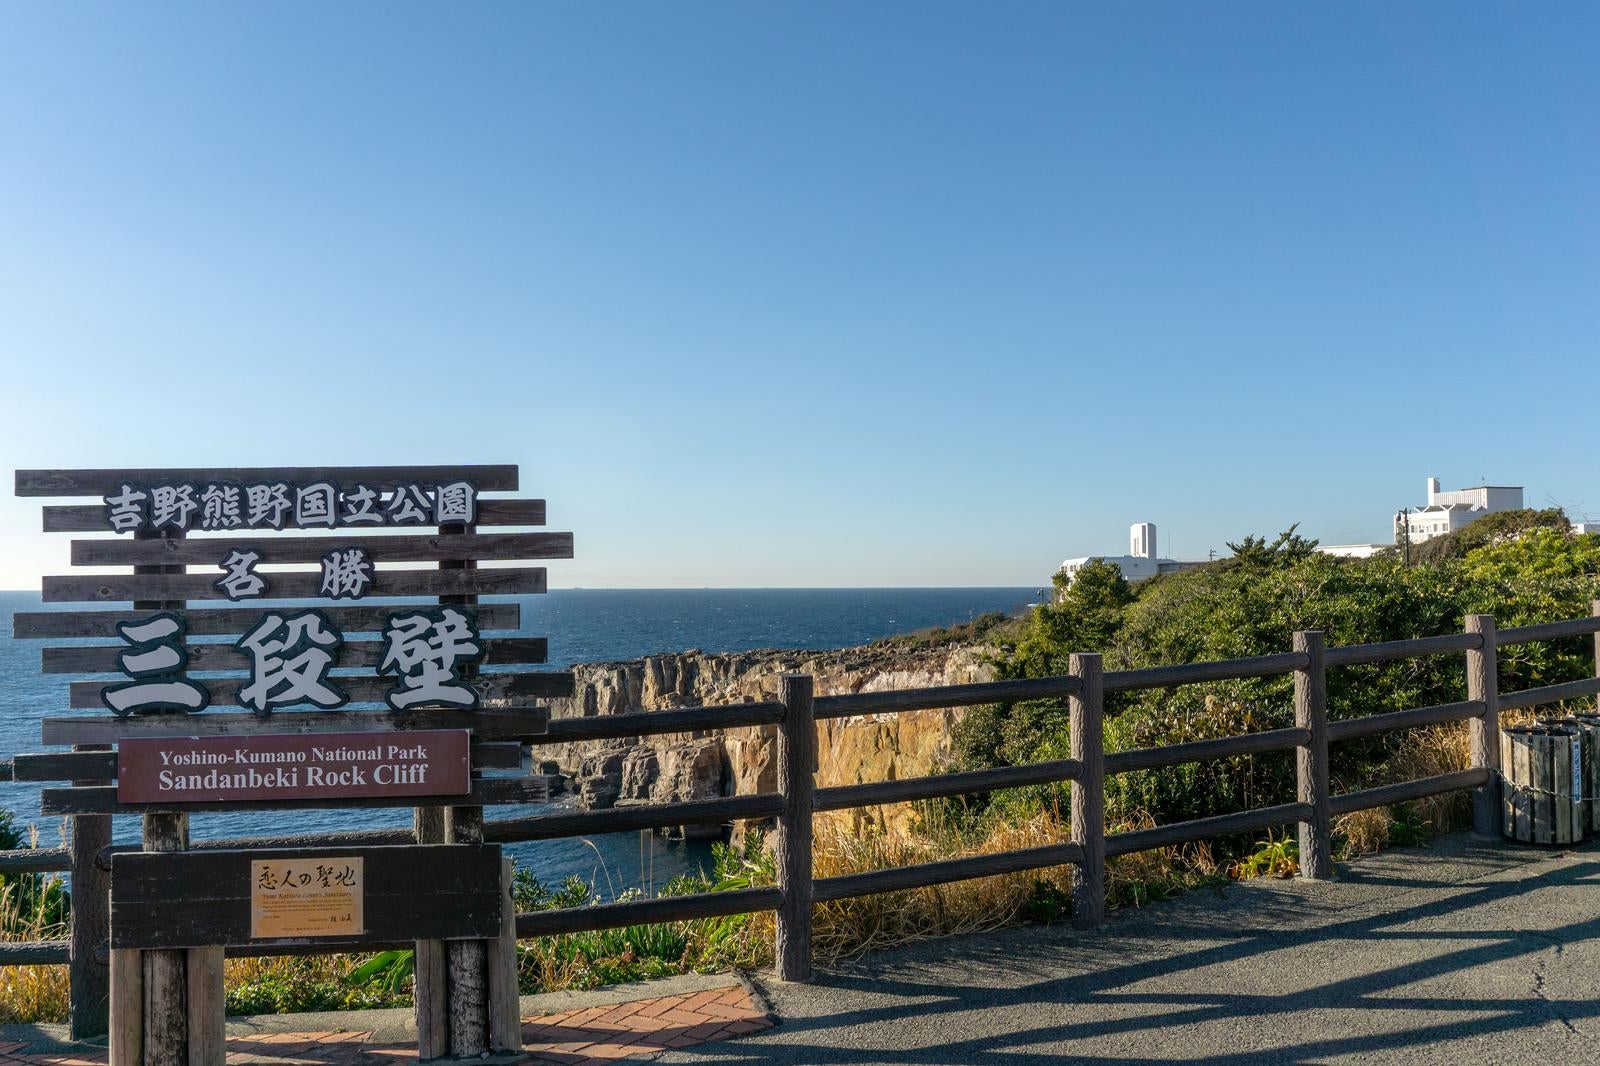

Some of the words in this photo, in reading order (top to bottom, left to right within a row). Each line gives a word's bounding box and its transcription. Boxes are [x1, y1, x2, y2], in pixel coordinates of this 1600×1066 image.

[105, 481, 475, 531] 吉野熊野国立公園
[217, 549, 371, 598] 名勝
[106, 606, 478, 711] 三段壁
[159, 749, 306, 766] Yoshino-Kumano
[312, 746, 382, 762] National
[387, 744, 428, 760] Park
[159, 766, 299, 791] Sandanbeki
[305, 765, 368, 787] Rock
[373, 763, 429, 785] Cliff
[258, 865, 356, 890] 恋人の聖地
